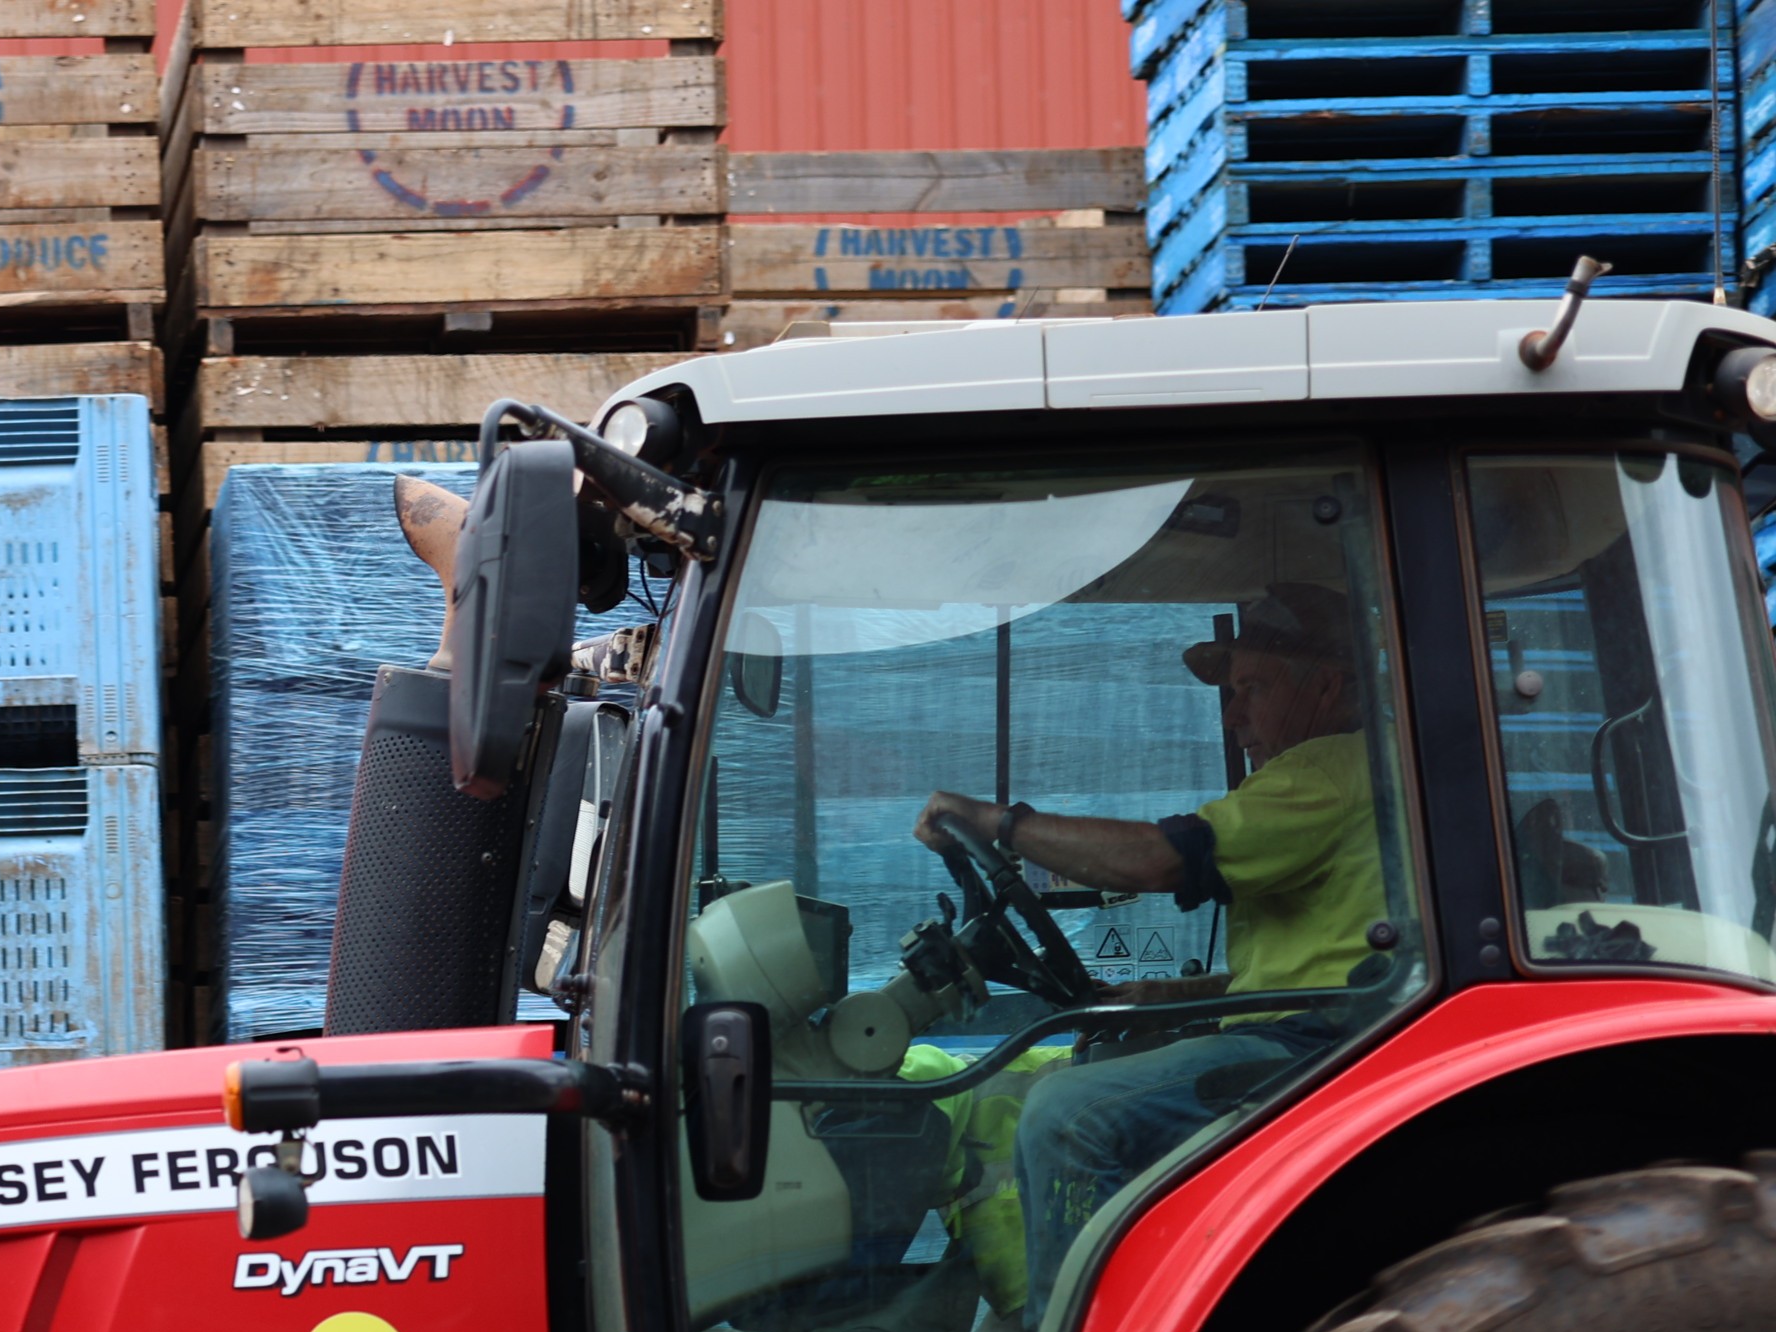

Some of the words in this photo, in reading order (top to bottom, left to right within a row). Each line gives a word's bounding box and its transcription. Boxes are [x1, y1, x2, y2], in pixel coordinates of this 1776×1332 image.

[374, 60, 543, 95] HARVEST
[406, 106, 515, 131] MOON
[840, 226, 997, 257] HARVEST
[233, 1244, 464, 1297] DynaVT
